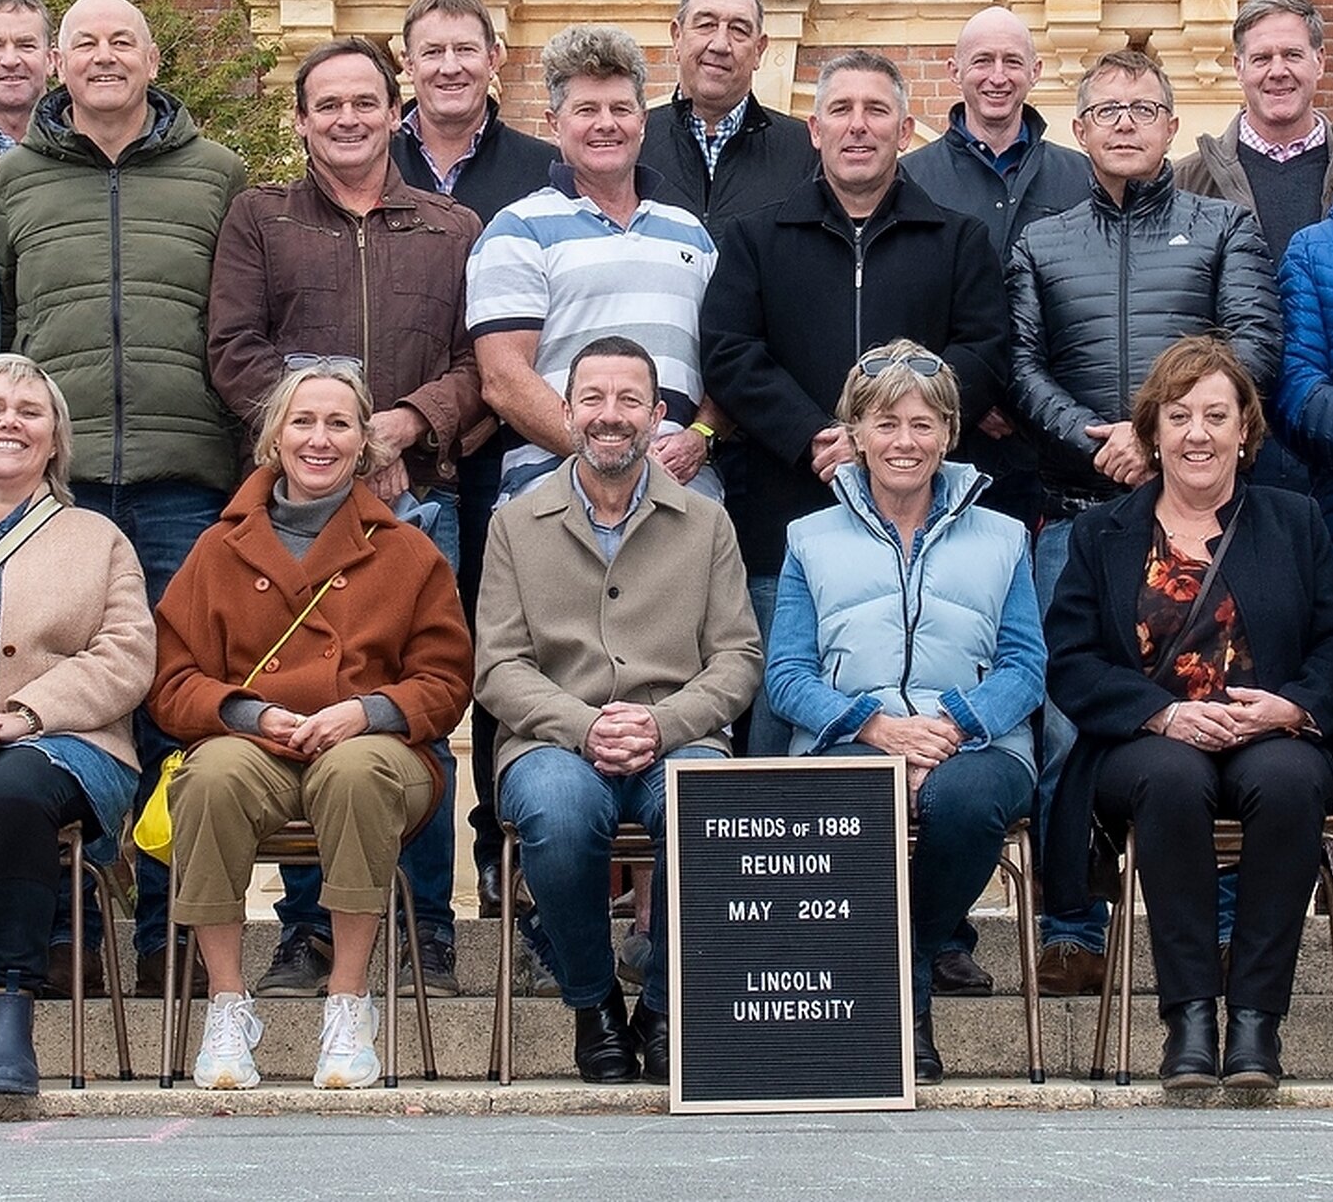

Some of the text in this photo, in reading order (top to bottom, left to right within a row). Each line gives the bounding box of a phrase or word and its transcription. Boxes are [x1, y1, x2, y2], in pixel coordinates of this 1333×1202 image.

[705, 816, 861, 838] FRIENDS OF 1988
[741, 854, 831, 875] REUNION
[728, 899, 851, 921] MAY 2024
[747, 971, 832, 992] LINCOLN
[733, 1000, 855, 1021] UNIVERSITY
